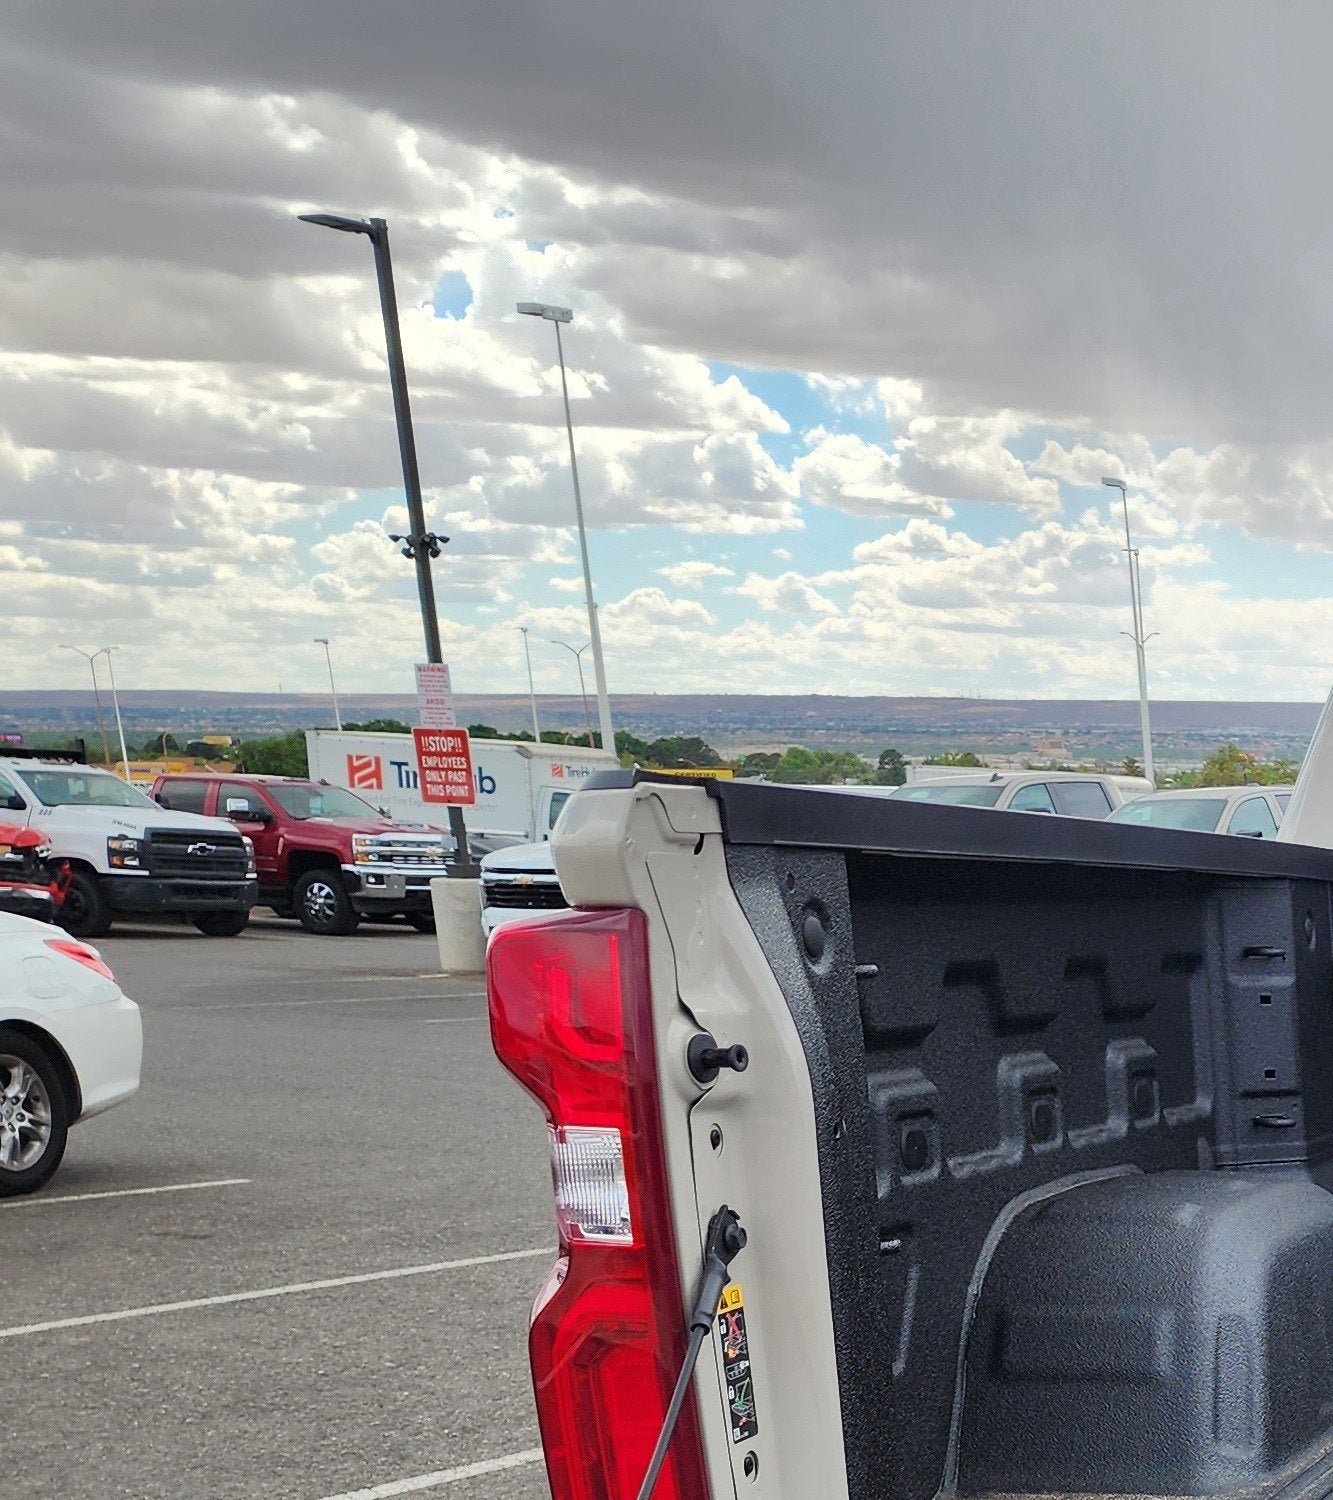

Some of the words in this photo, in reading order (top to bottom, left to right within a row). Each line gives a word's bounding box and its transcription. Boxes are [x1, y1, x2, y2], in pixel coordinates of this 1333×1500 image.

[421, 736, 463, 753] !!STOP!!
[421, 755, 467, 769] EMPLOYEES
[425, 769, 446, 782] ONLY
[447, 770, 467, 783] PAST
[426, 783, 445, 796] THIS
[445, 784, 469, 797] POINT
